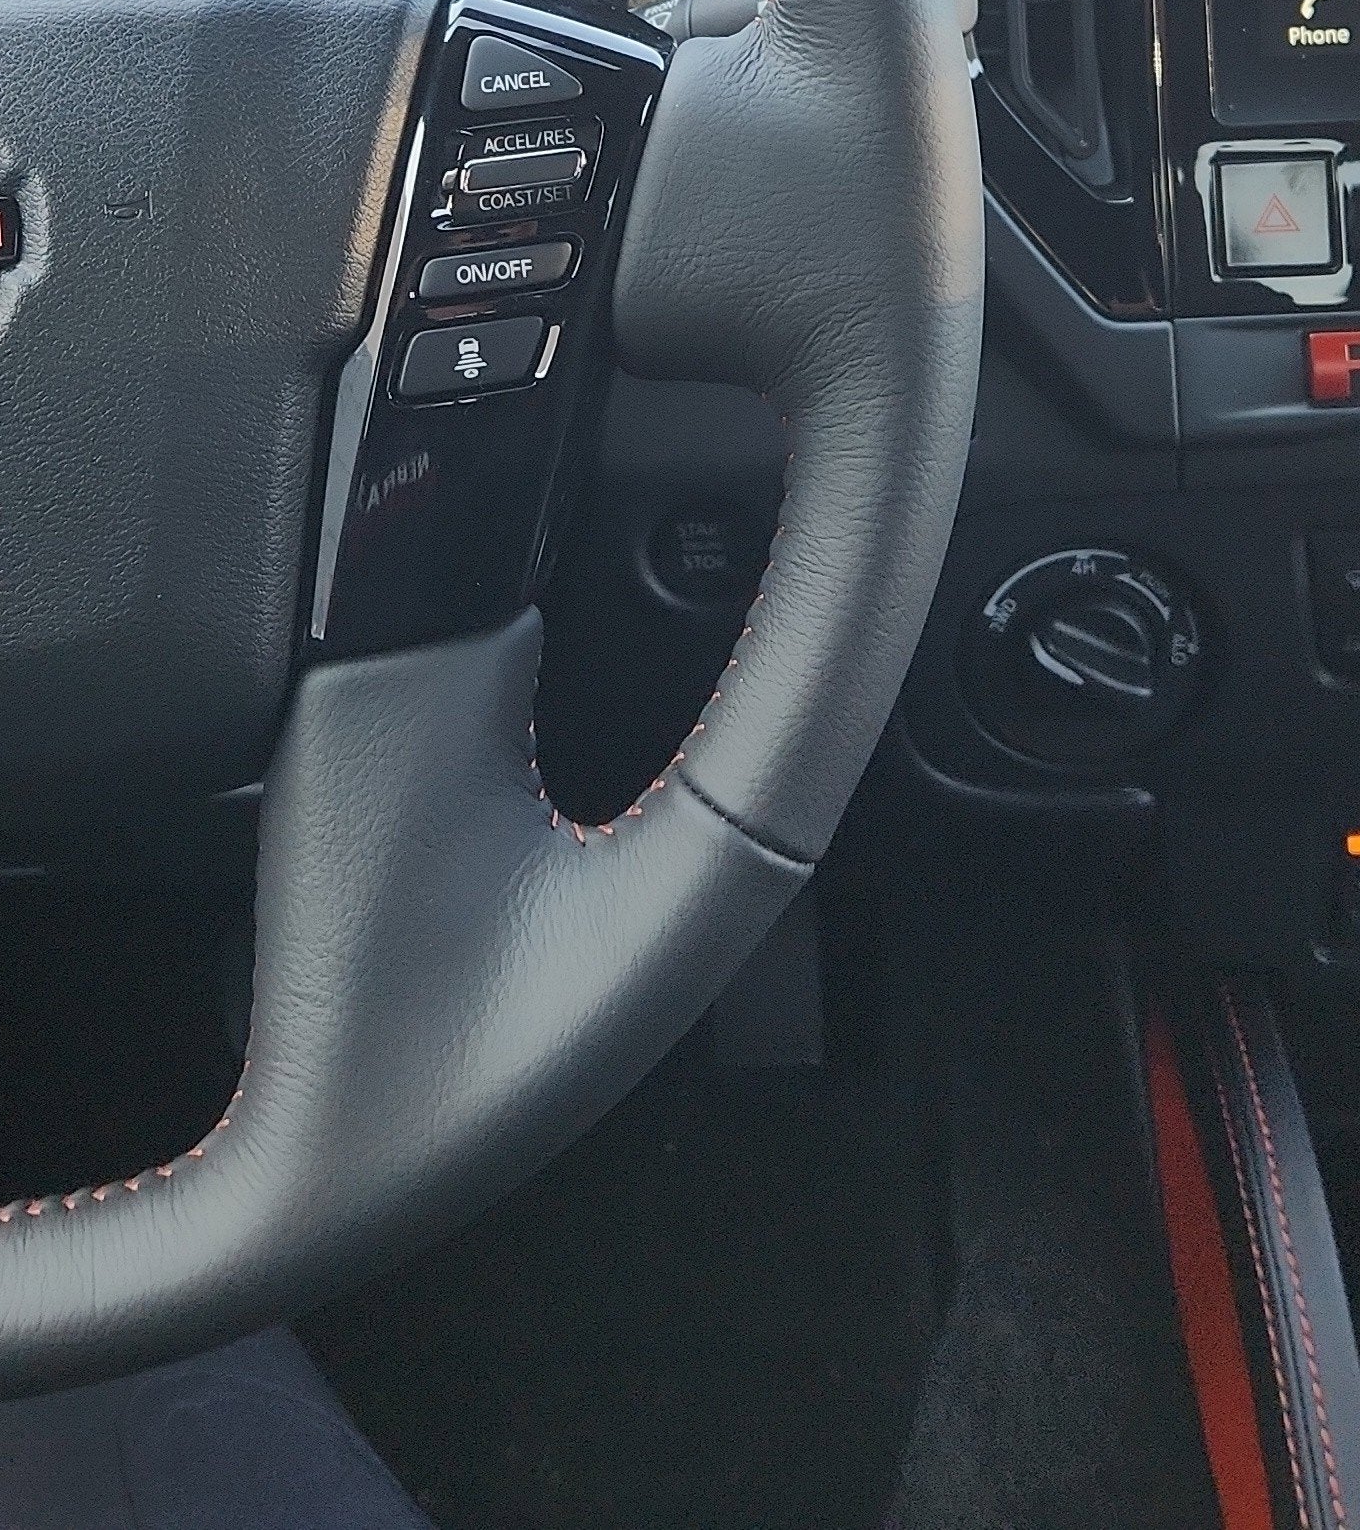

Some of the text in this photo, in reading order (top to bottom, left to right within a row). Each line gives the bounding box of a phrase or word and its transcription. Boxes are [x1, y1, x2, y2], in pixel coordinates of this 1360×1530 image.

[1289, 26, 1351, 45] Phone
[480, 70, 550, 93] CANCEL
[483, 128, 575, 154] ACCEL/RES
[479, 184, 573, 212] COAST/SET
[456, 259, 533, 285] ON/OFF
[1070, 559, 1097, 575] 4H
